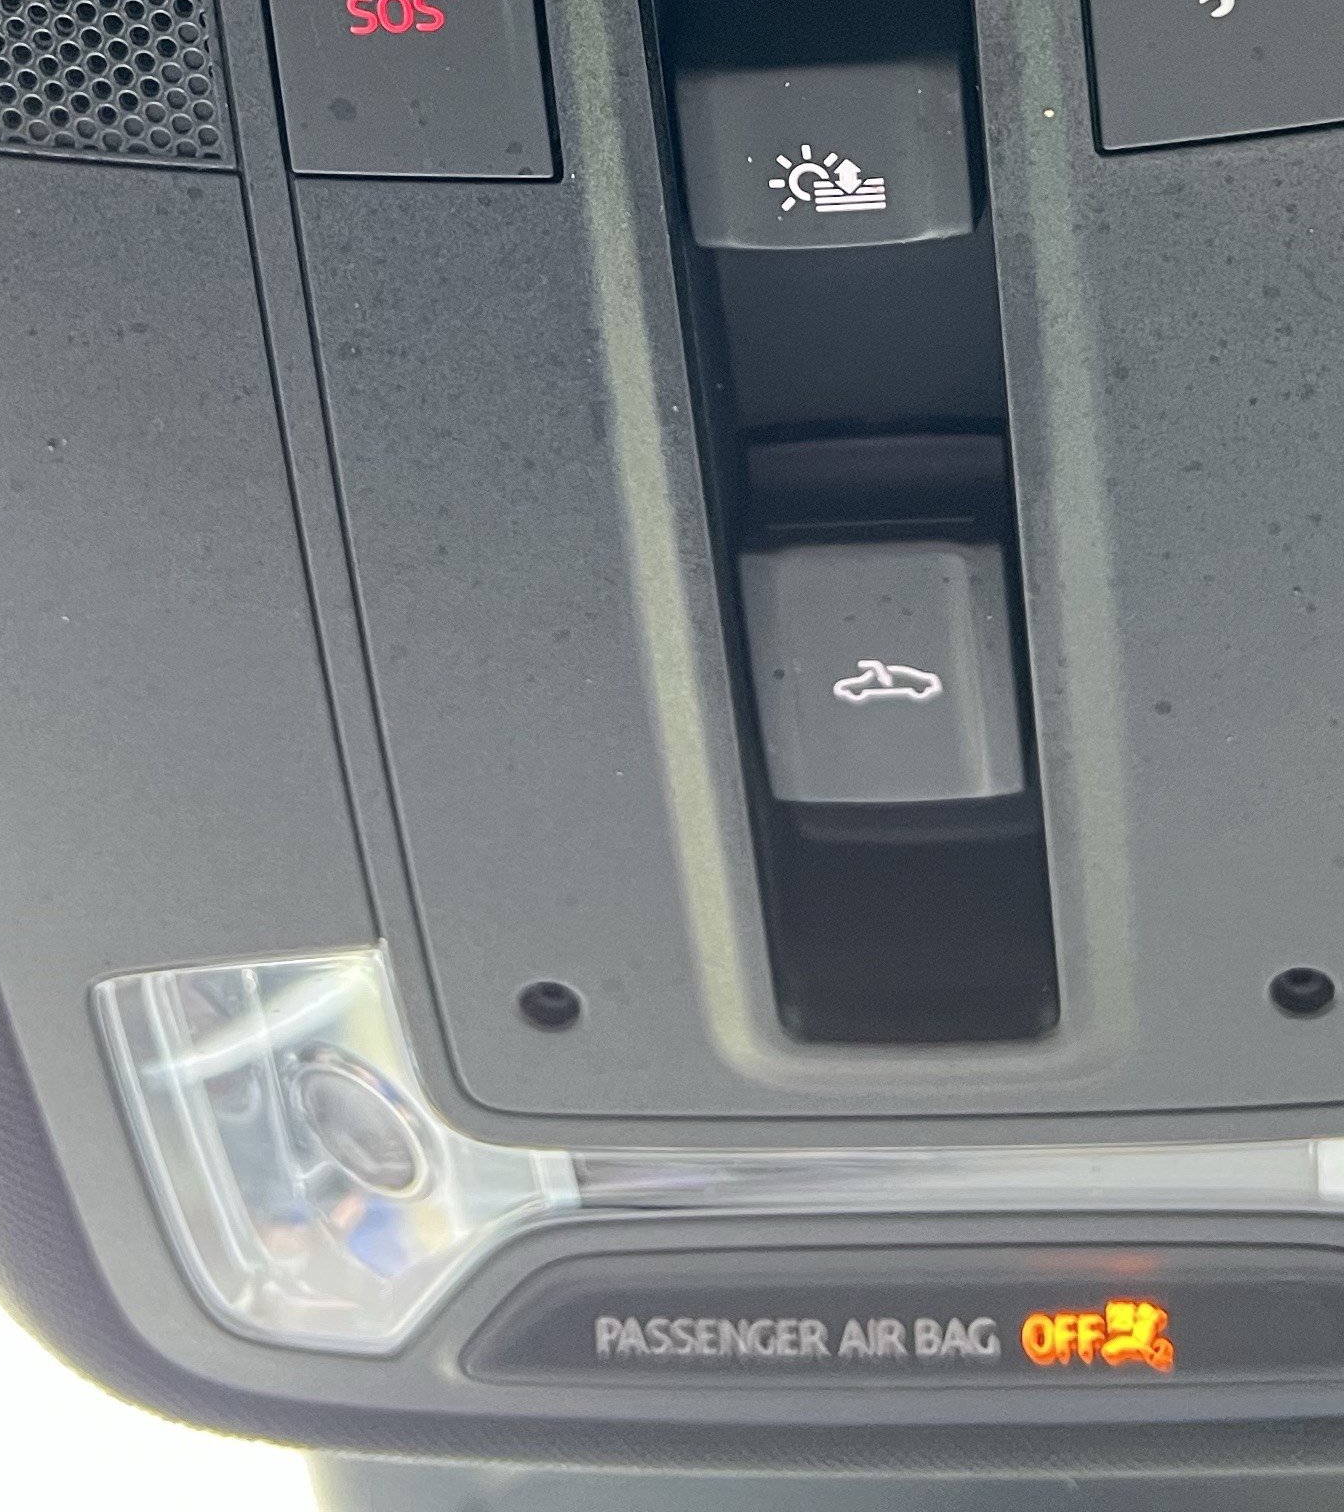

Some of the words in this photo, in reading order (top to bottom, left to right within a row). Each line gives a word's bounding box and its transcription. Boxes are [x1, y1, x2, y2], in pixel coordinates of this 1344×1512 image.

[594, 1316, 831, 1357] PASSENGER
[837, 1316, 908, 1357] AIR
[914, 1317, 1001, 1357] BAG
[1022, 1313, 1105, 1365] OFF
